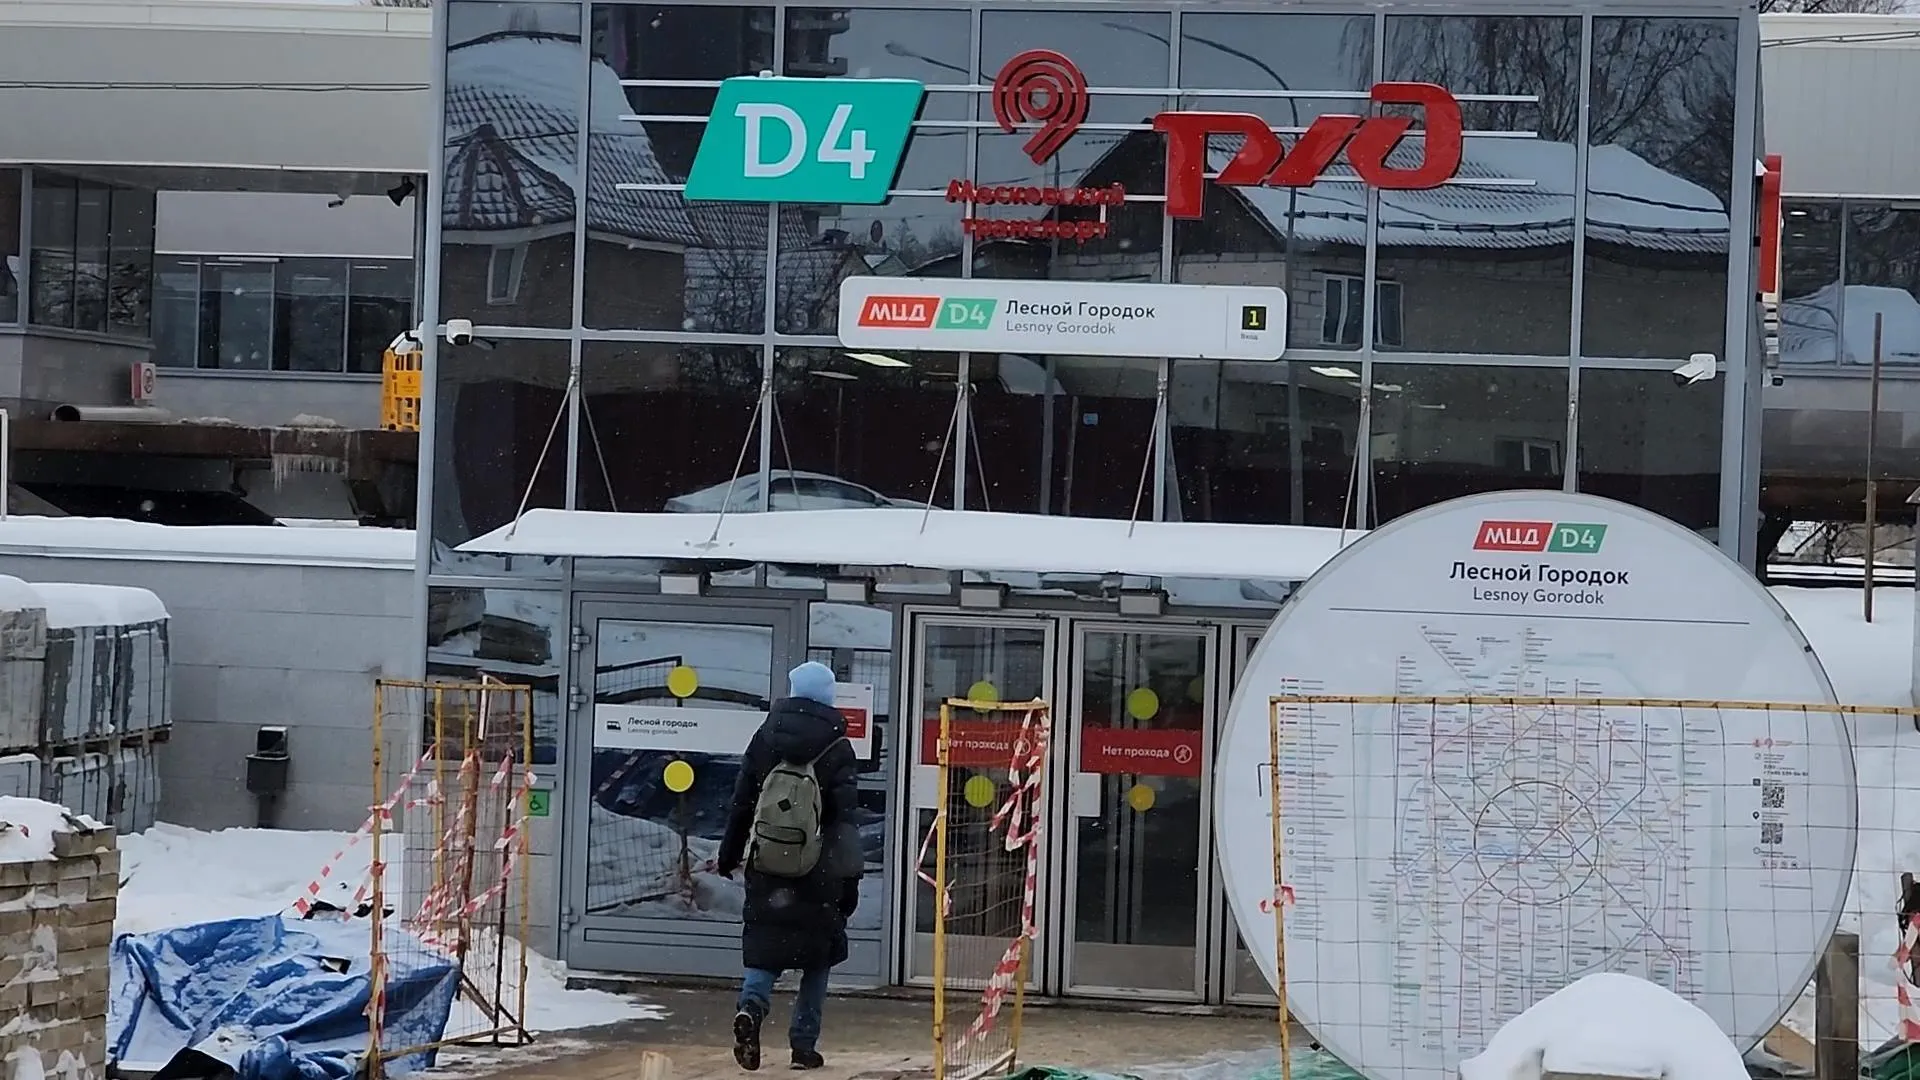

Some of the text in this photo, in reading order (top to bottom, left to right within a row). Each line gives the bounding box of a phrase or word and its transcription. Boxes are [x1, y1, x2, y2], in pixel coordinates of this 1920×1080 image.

[734, 103, 876, 179] D4
[946, 179, 1124, 205] Московский
[961, 219, 1108, 244] транспорт
[868, 303, 986, 324] МЦД D4
[1005, 300, 1156, 319] Лесной Городок
[1249, 310, 1259, 326] 1
[1006, 320, 1116, 335] Lesnoy Gorodok
[1484, 527, 1596, 548] МЦД D4
[1449, 561, 1630, 587] Лесной Городок
[1473, 586, 1605, 605] Lesnoy Gorodok
[627, 716, 698, 729] Лесной городок
[1102, 745, 1170, 758] Нет прохода
